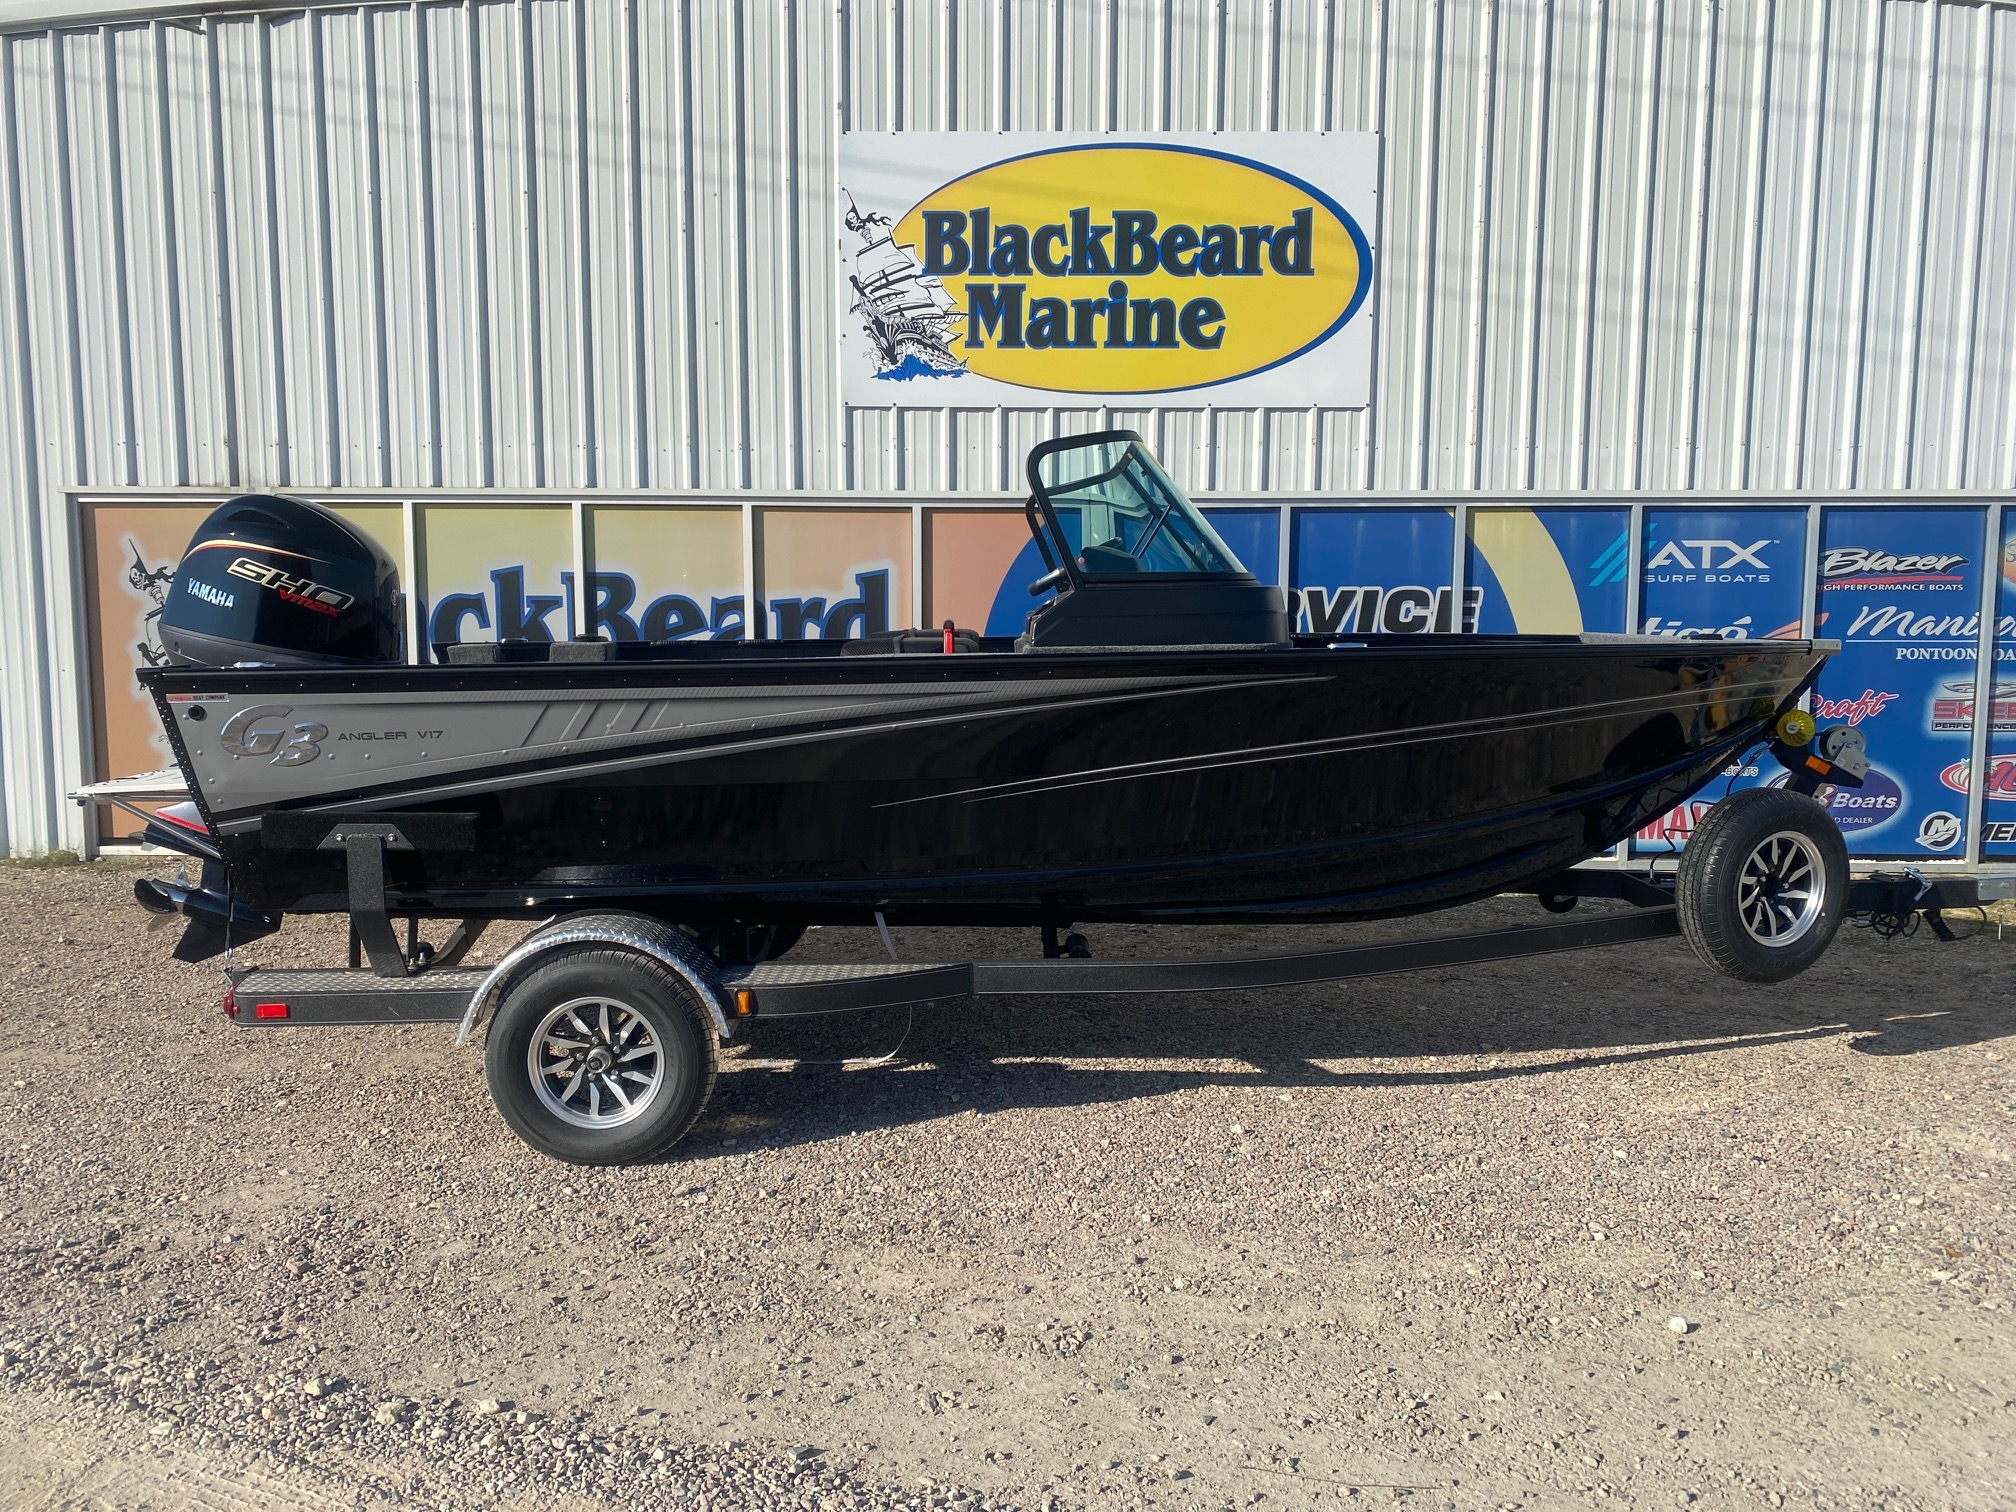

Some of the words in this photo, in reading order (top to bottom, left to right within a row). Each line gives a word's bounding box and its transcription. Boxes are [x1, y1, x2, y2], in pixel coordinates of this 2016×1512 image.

[921, 206, 1315, 277] BlackBeard
[964, 280, 1226, 350] Marine
[1645, 539, 1772, 569] ATX
[1818, 546, 1969, 578] Blazer
[187, 577, 235, 609] YAMAHA
[226, 557, 355, 610] SHO
[1644, 574, 1697, 583] SURF
[1704, 574, 1771, 583] BOATS
[1844, 583, 1926, 592] PERFORMANCE
[1928, 583, 1965, 592] BOATS
[1896, 647, 1978, 660] PONTOON
[220, 704, 329, 767] G3
[337, 731, 407, 741] ANGLER
[416, 730, 444, 740] V17
[1832, 792, 1898, 808] Boats
